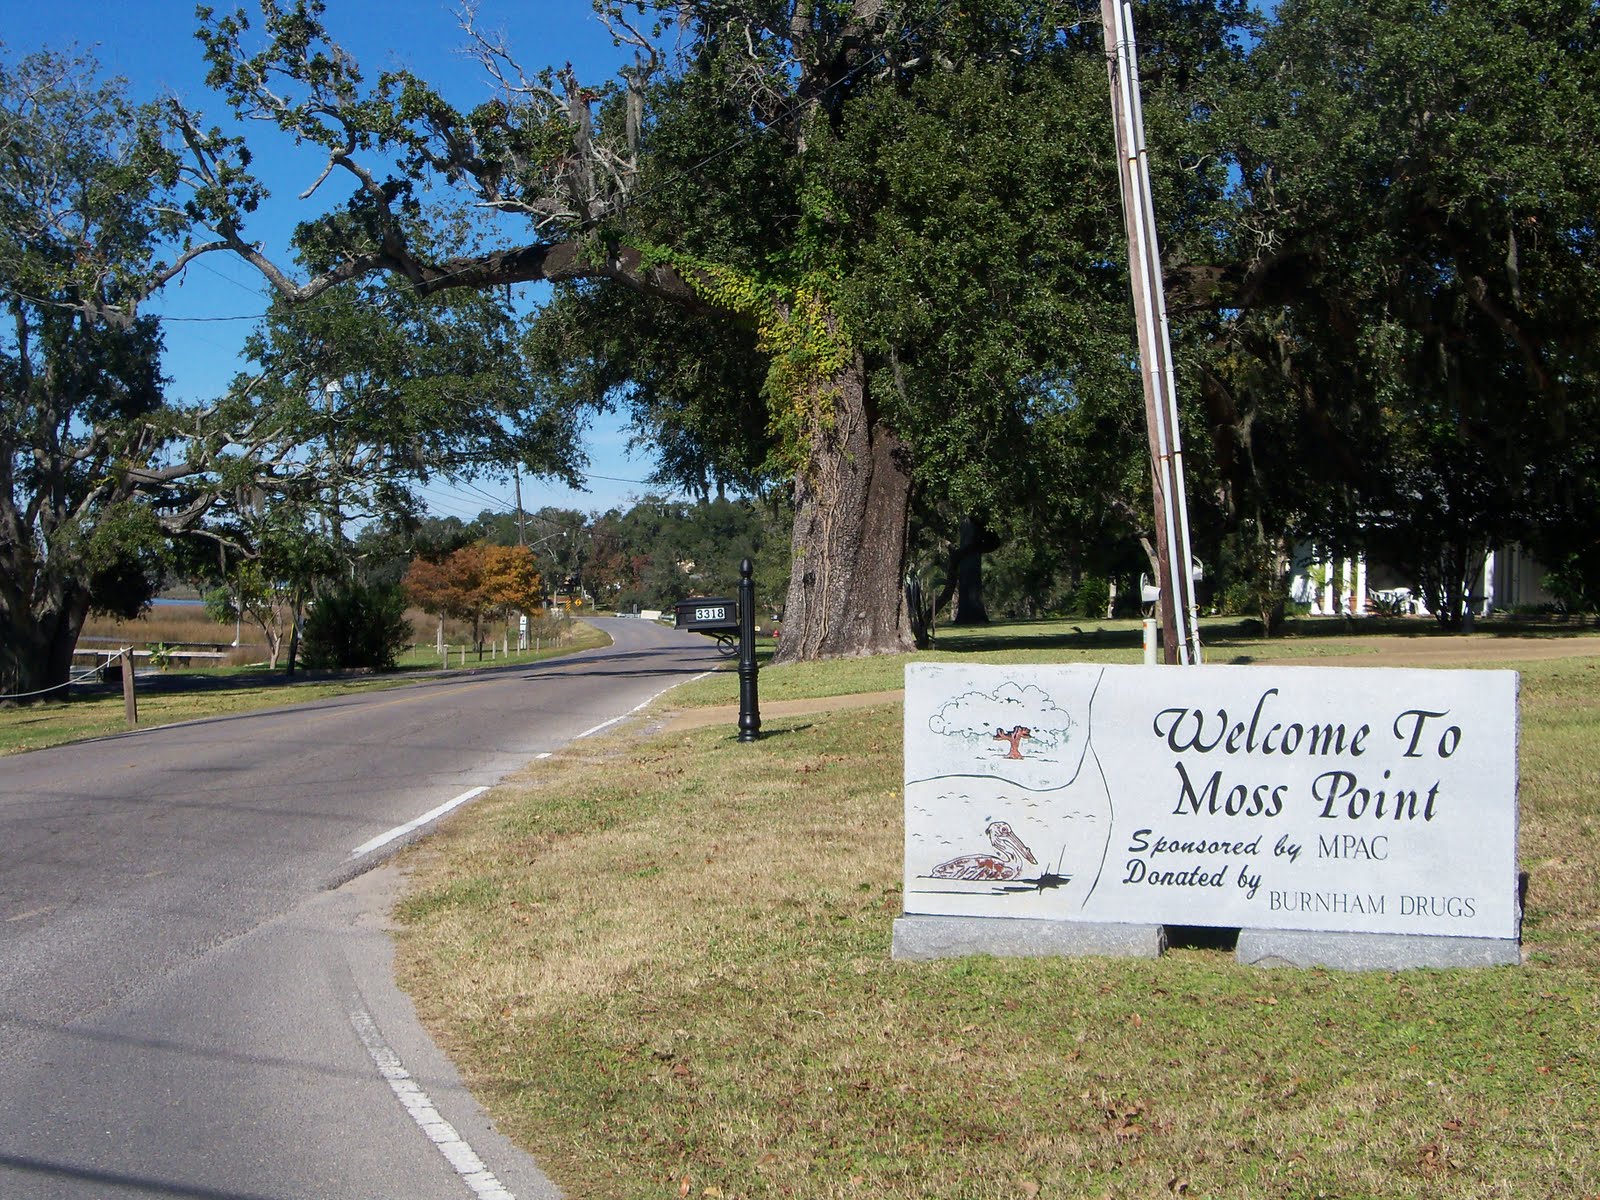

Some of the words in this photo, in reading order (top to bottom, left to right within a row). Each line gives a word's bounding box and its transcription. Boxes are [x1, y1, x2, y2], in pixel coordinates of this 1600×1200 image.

[697, 608, 724, 619] 3318
[1153, 688, 1370, 756] Welcome
[1393, 708, 1462, 759] To
[1171, 761, 1289, 818] Moss
[1311, 769, 1441, 822] Point
[1127, 828, 1263, 858] Sponsored
[1273, 833, 1302, 863] by
[1317, 834, 1389, 861] MPAC
[1122, 858, 1228, 887] Donated
[1237, 864, 1262, 900] by
[1269, 890, 1385, 915] BURNHAM
[1400, 895, 1476, 918] DRUGS
